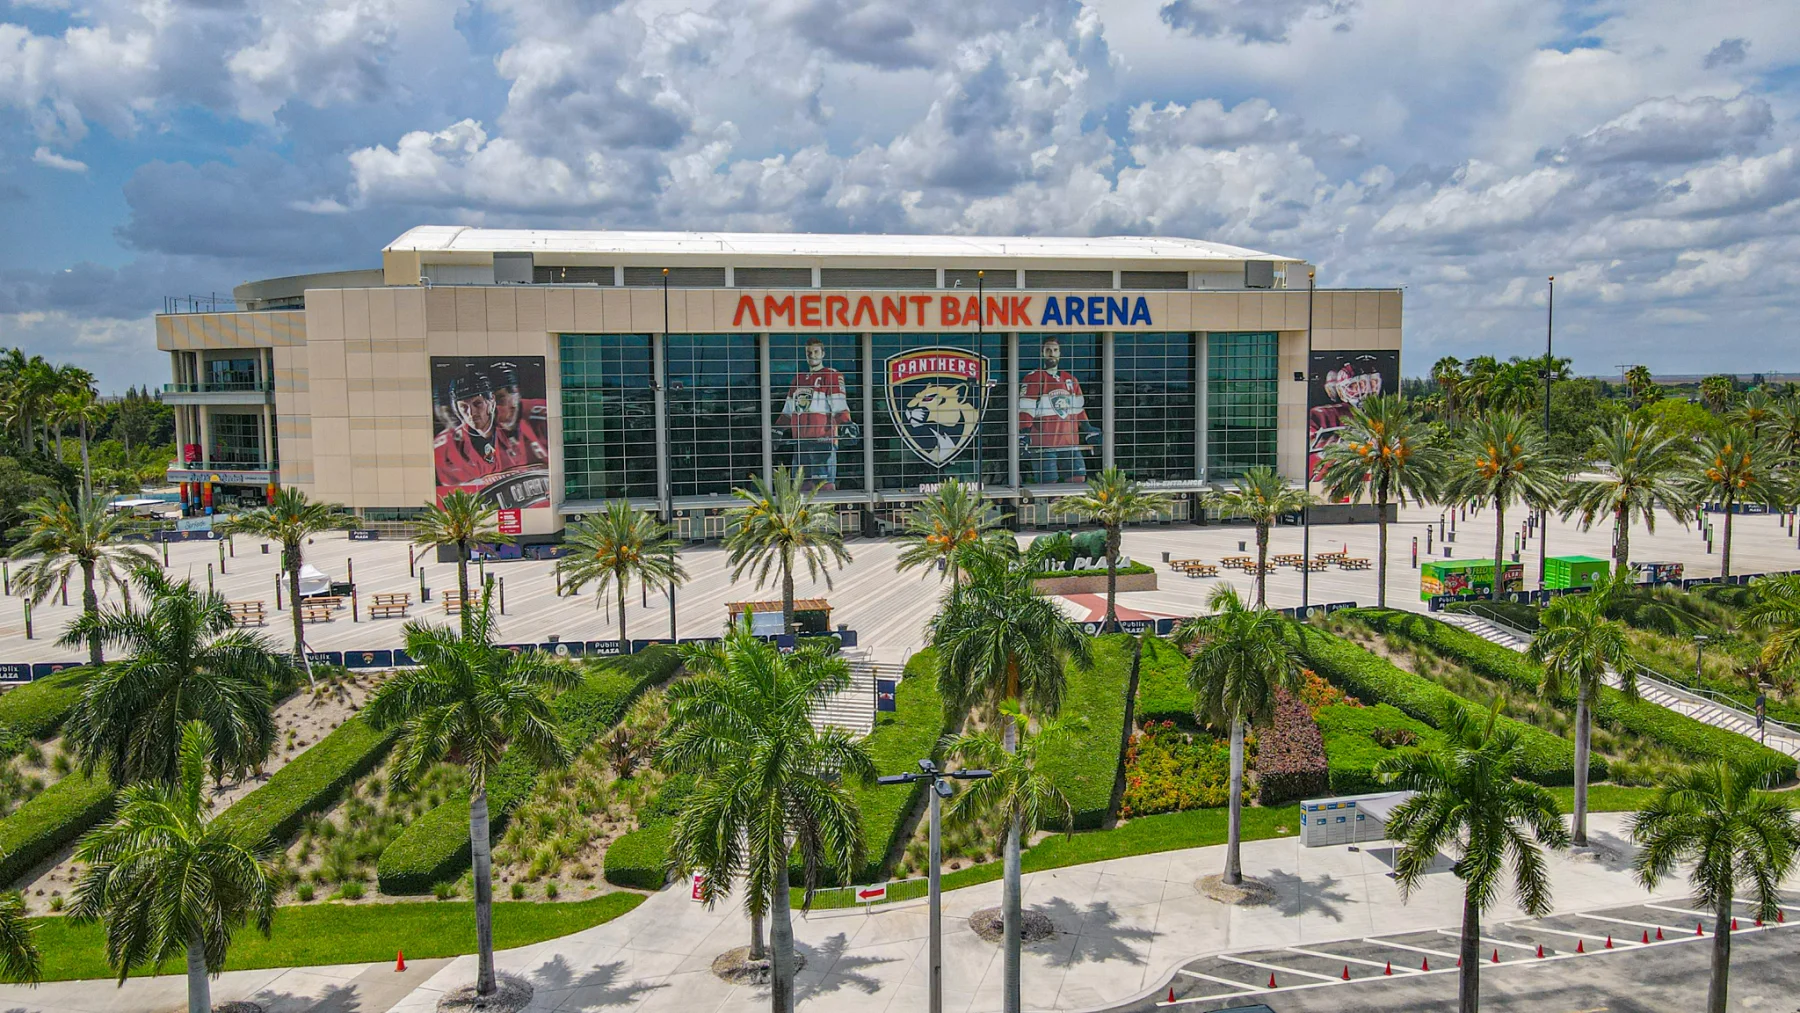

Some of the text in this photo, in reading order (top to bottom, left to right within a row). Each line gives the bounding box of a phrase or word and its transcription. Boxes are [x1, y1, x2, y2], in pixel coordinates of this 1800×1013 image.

[732, 295, 1153, 327] AMERANT BANK ARENA
[898, 357, 977, 378] PANTHERS
[1008, 555, 1131, 573] Plix PLAA
